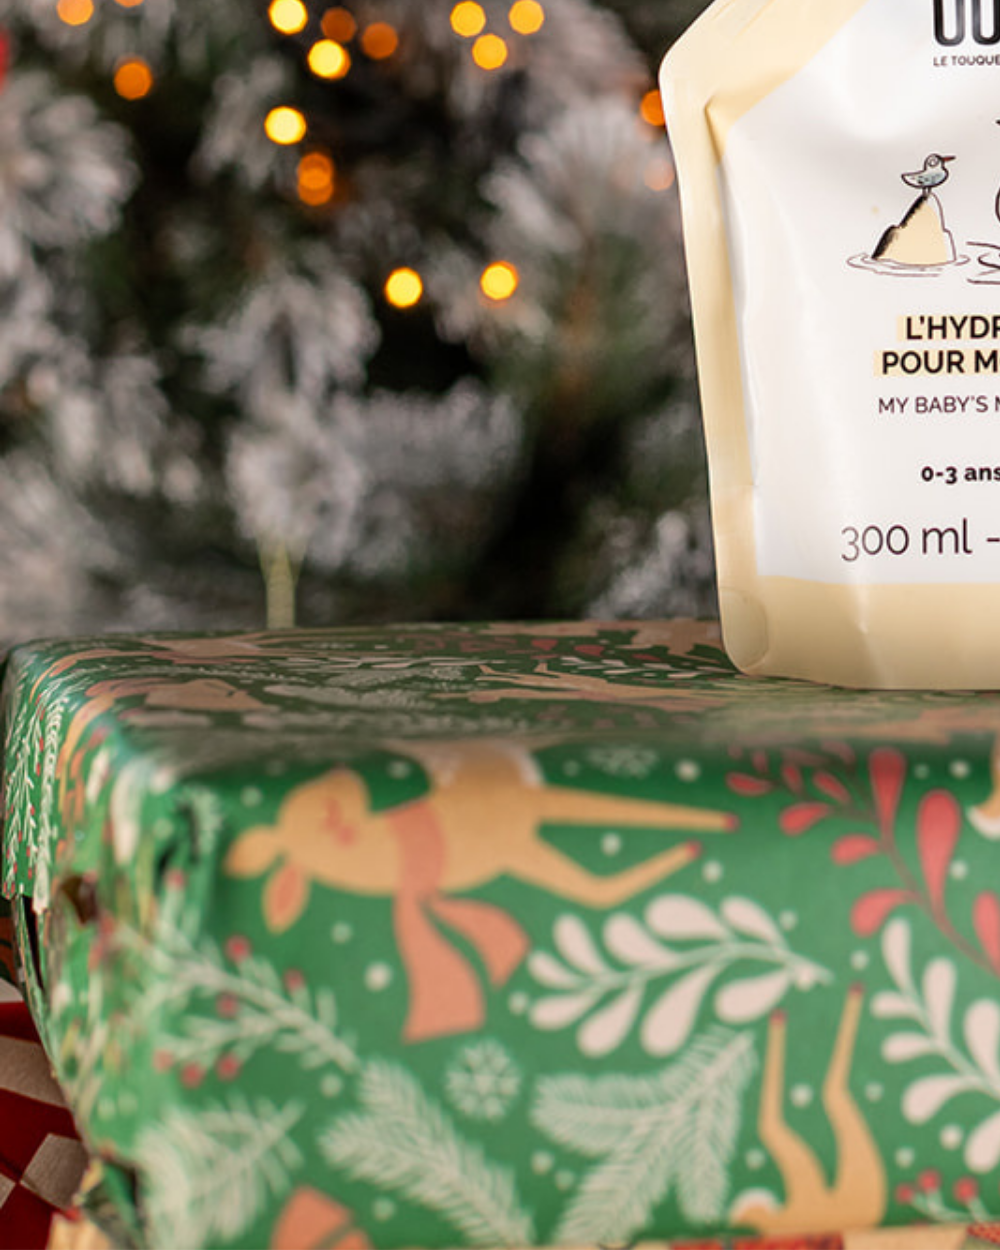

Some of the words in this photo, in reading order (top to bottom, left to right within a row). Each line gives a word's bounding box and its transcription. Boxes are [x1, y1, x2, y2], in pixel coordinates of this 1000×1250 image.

[933, 55, 947, 67] LE
[882, 350, 965, 375] POUR
[878, 397, 909, 414] MY
[915, 396, 989, 414] BABY'S
[921, 466, 958, 485] 0-3
[841, 524, 910, 562] 300
[922, 517, 973, 555] ml
